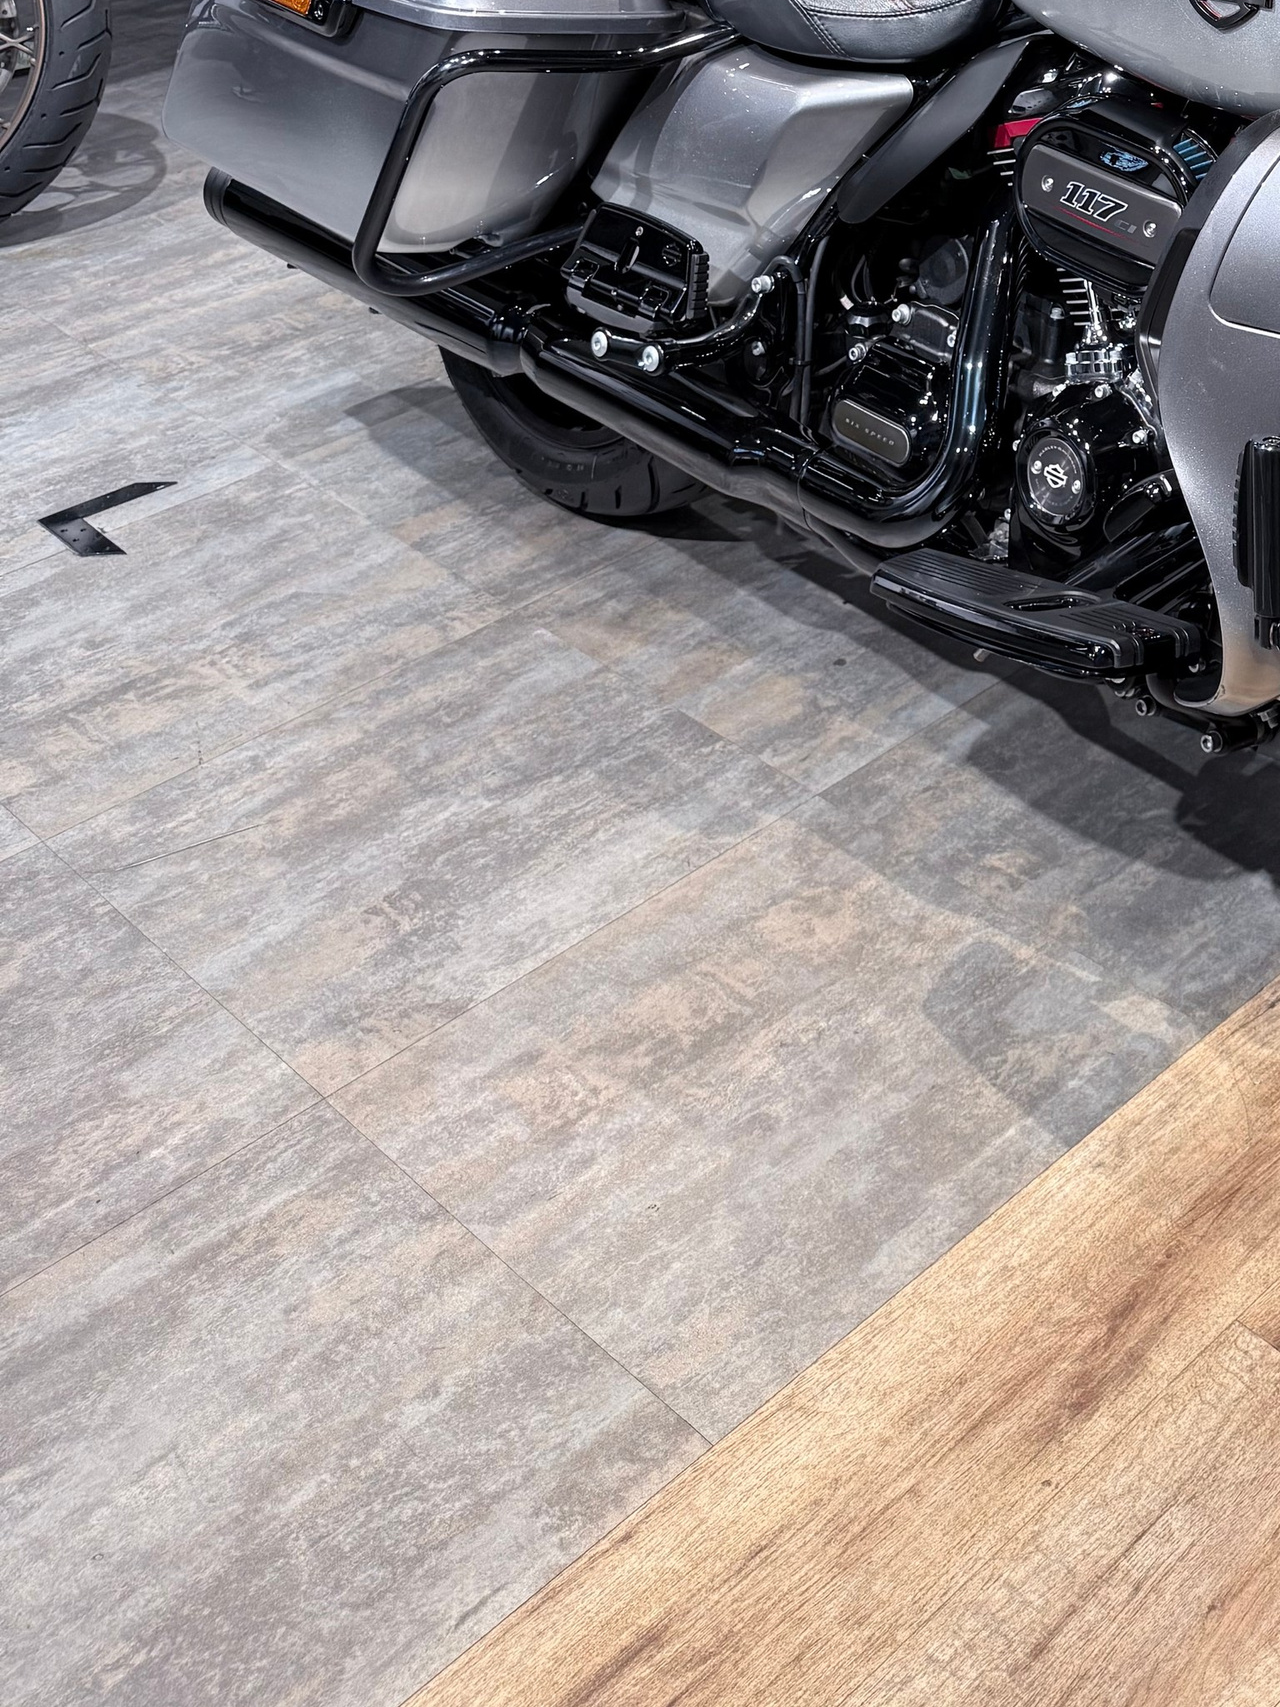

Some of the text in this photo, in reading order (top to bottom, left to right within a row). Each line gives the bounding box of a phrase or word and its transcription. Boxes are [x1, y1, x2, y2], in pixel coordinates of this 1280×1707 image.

[1060, 181, 1128, 222] 117
[845, 418, 894, 445] SIX SPEED
